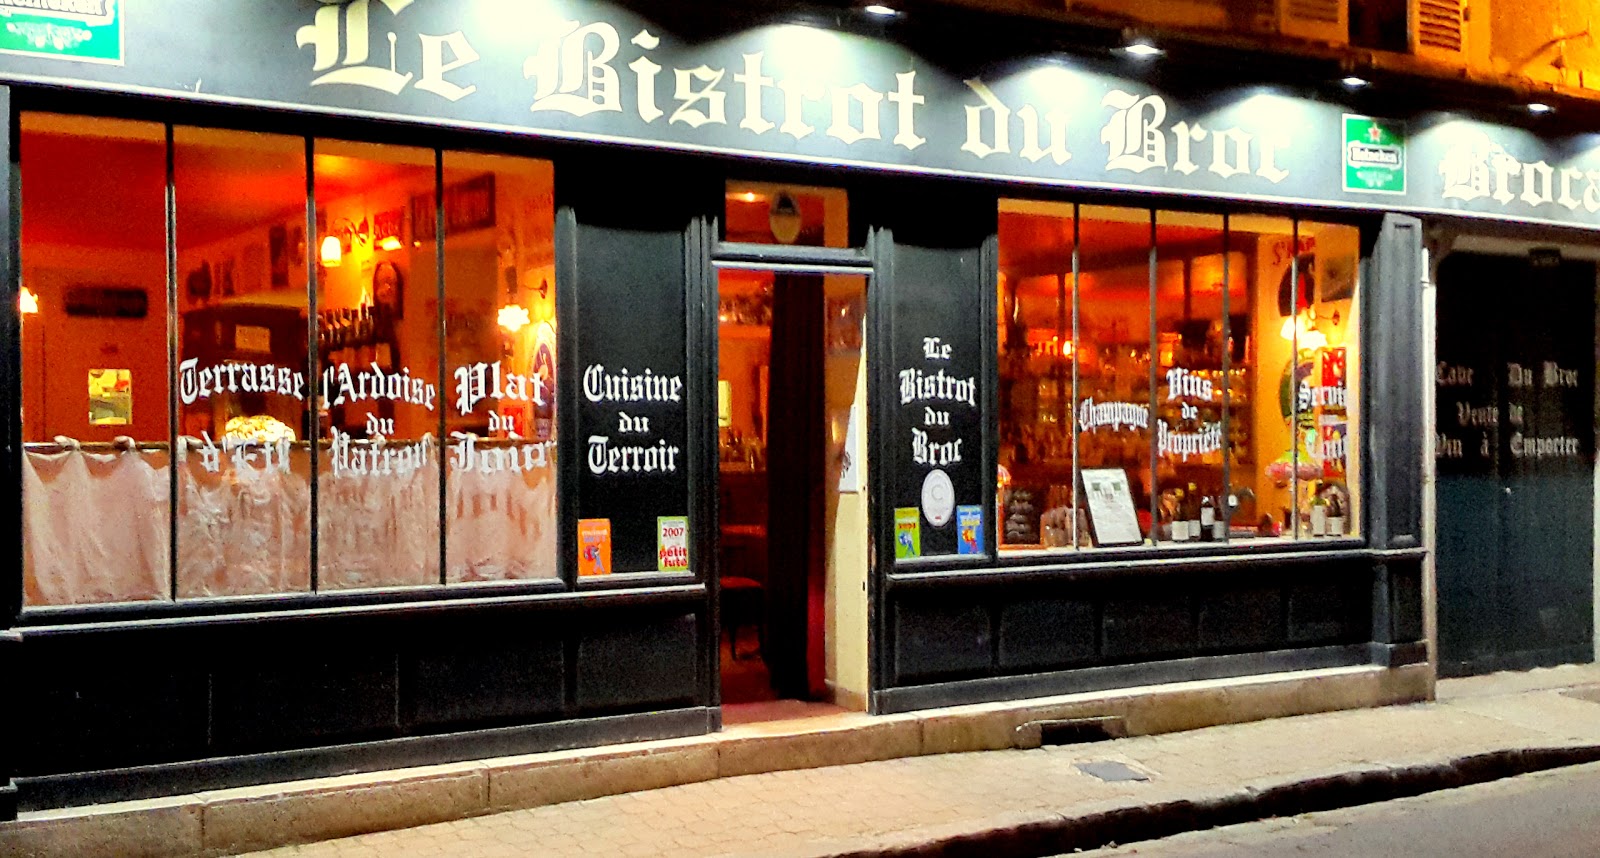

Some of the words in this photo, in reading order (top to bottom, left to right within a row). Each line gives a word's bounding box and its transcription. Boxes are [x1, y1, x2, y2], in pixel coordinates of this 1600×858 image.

[296, 0, 481, 102] Le
[523, 20, 927, 150] Bistrot
[960, 77, 1073, 166] du
[1101, 89, 1290, 184] Broc
[923, 337, 953, 360] Le
[180, 357, 305, 404] Terrasse
[323, 362, 436, 411] l'Ardoise
[454, 360, 543, 416] Plat
[583, 364, 683, 403] Cuisine
[899, 368, 976, 406] Bistrot
[1166, 367, 1213, 401] Vins
[1507, 362, 1533, 388] Du
[1542, 360, 1579, 388] Broc
[366, 412, 394, 435] du
[488, 410, 514, 431] du
[618, 411, 649, 432] du
[924, 406, 950, 426] du
[1079, 396, 1149, 434] Champagne
[1181, 402, 1199, 420] de
[1456, 400, 1500, 428] Vente
[330, 425, 430, 478] Patron
[588, 435, 679, 474] Terroir
[911, 427, 962, 466] Broc
[1157, 419, 1222, 463] Propriété
[1509, 432, 1580, 460] Emporter
[662, 527, 685, 538] 2007
